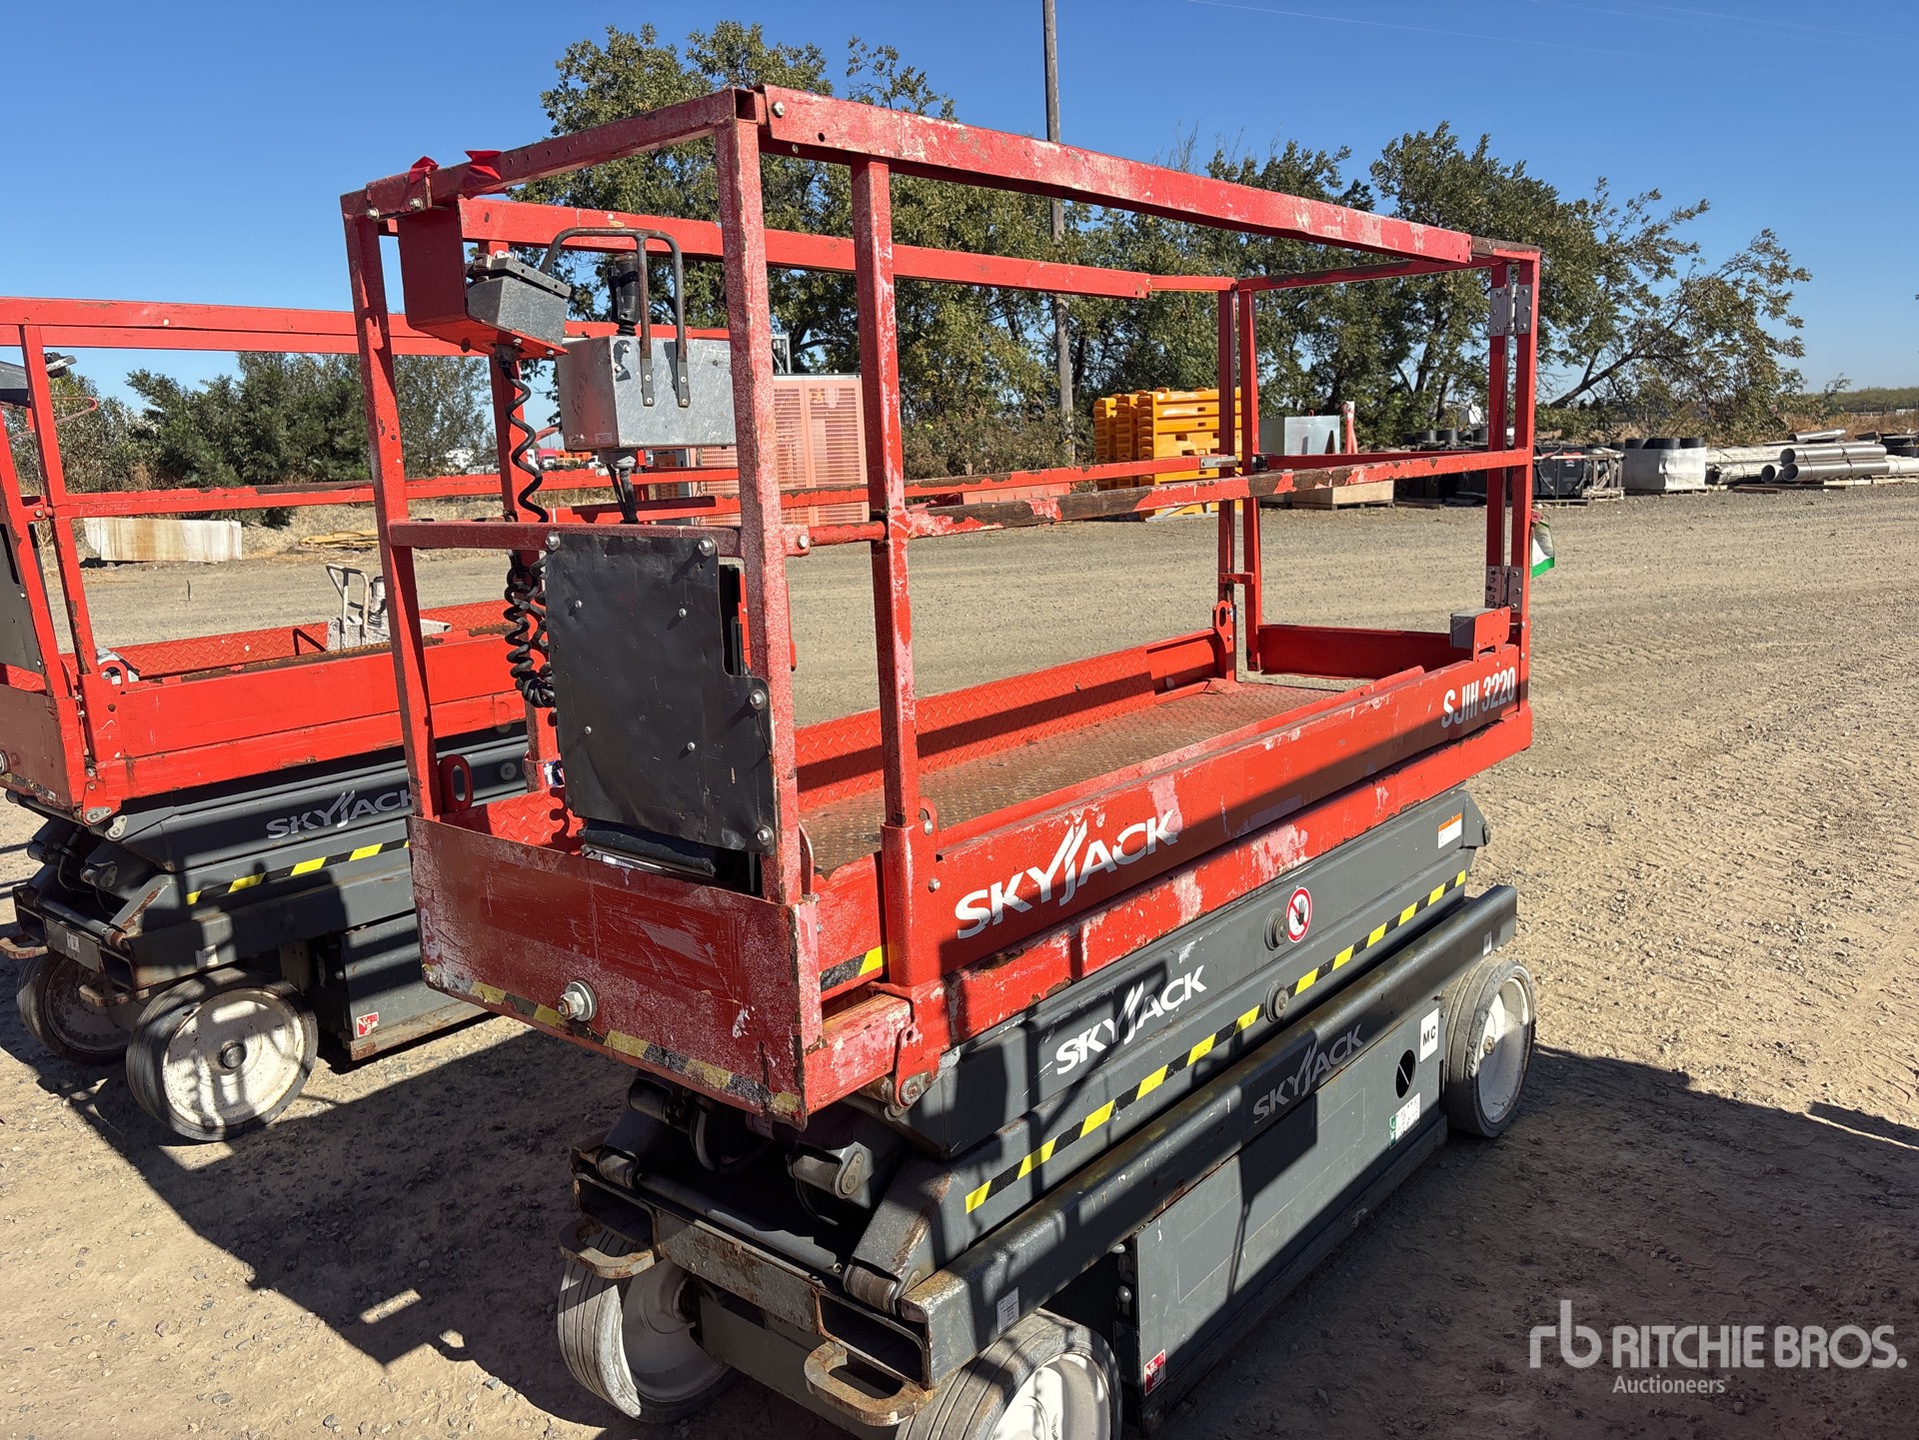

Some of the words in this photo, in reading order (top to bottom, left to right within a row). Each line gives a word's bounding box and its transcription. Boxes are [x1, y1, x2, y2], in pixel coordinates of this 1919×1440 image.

[1481, 666, 1516, 712] 3220
[954, 809, 1179, 939] SKYJACK
[1056, 965, 1207, 1075] SKYJACK
[1422, 1025, 1437, 1047] MC
[1253, 1023, 1364, 1124] SKYJACK
